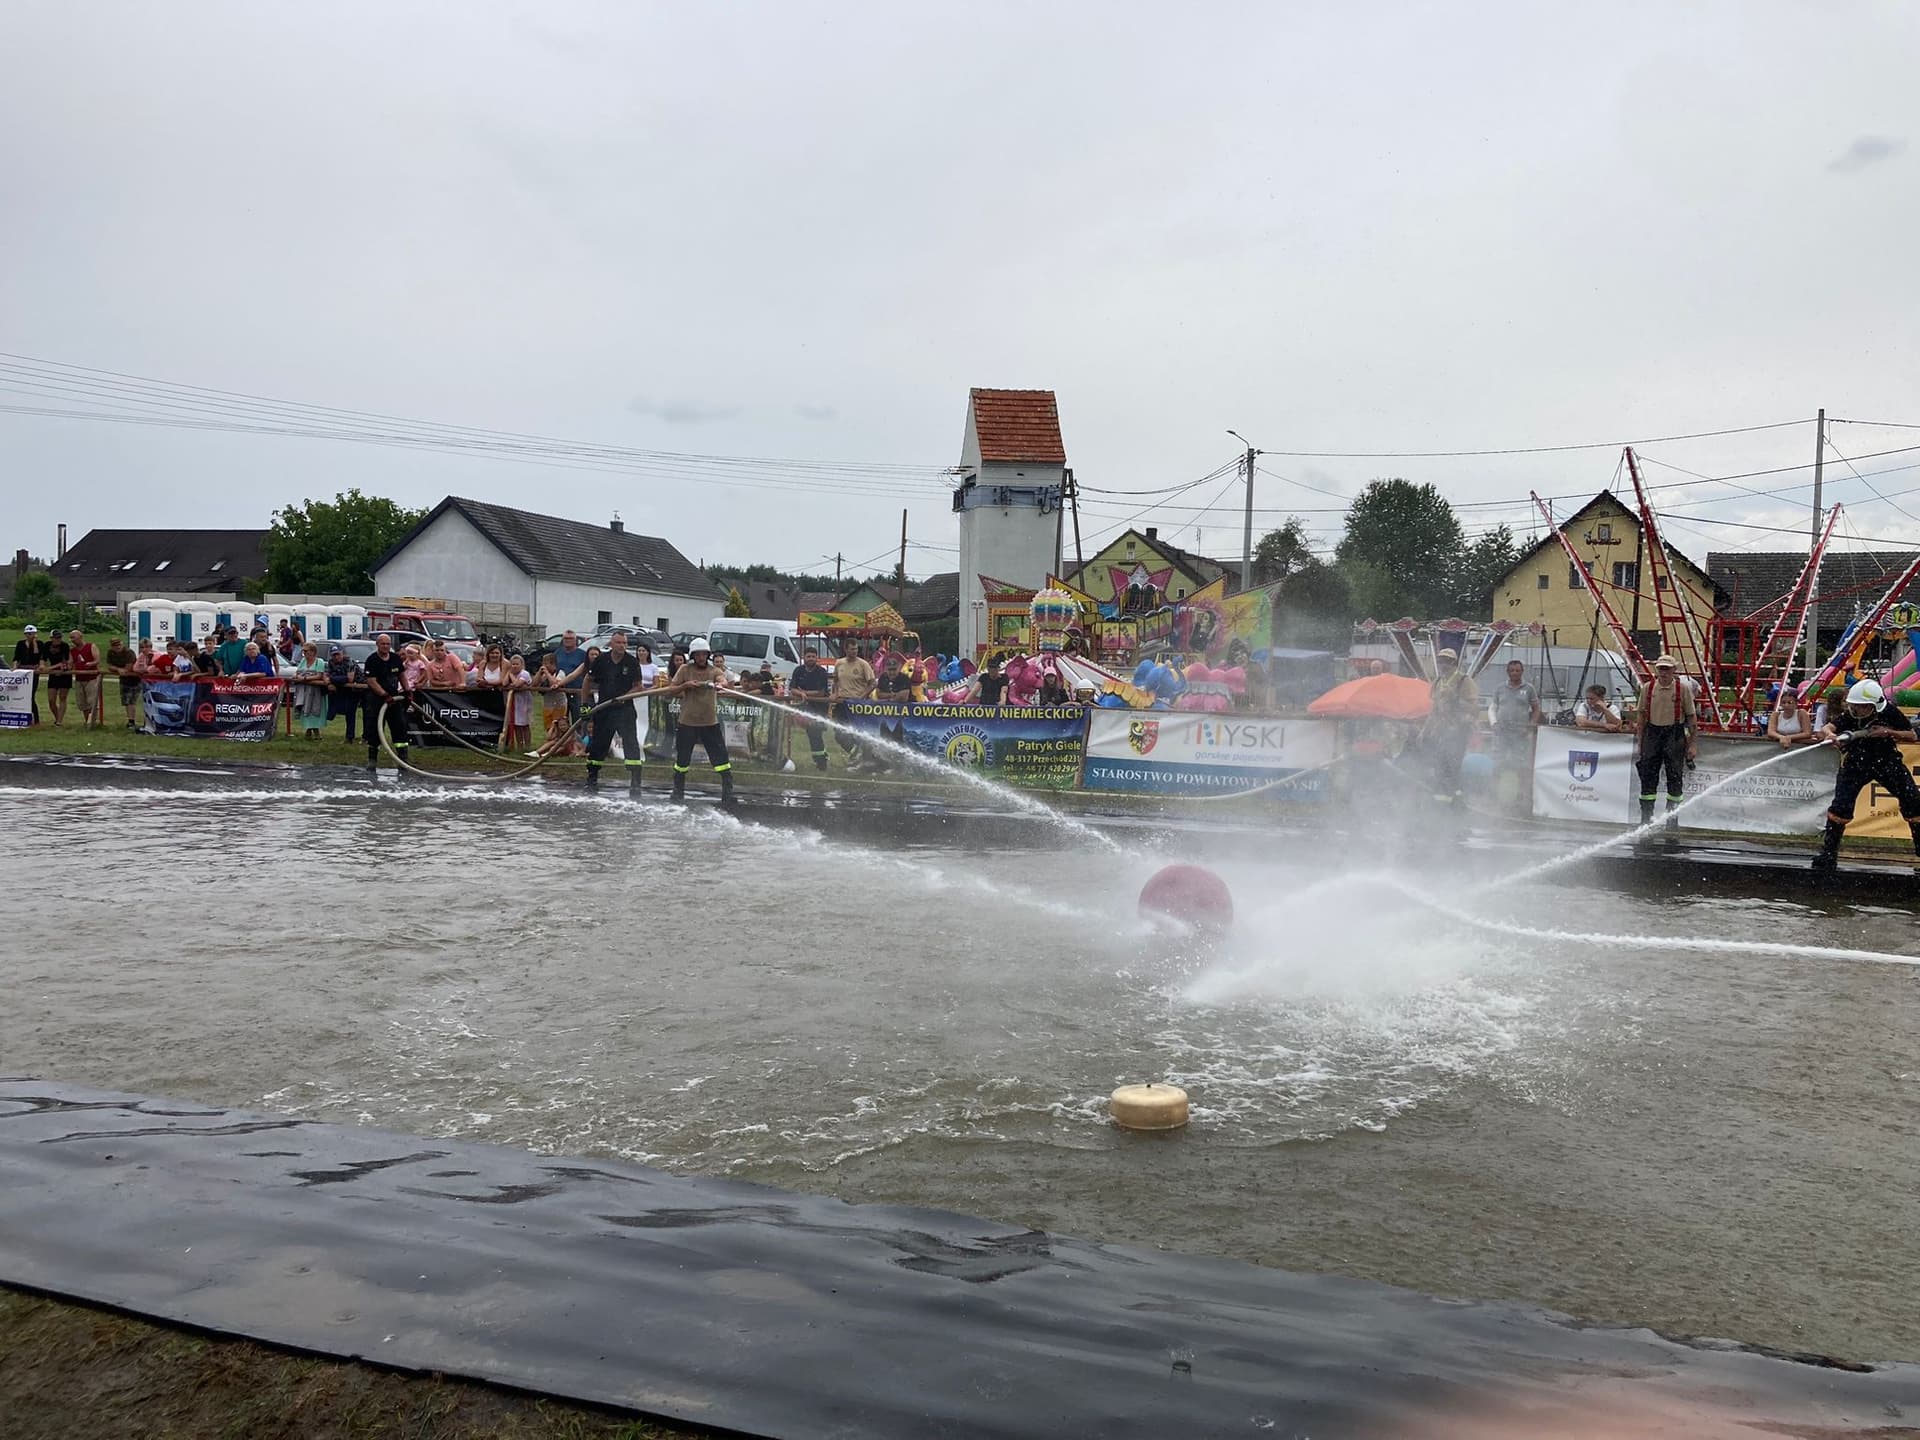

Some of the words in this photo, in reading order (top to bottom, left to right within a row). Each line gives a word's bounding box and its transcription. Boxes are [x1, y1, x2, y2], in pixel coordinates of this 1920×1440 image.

[1509, 599, 1520, 607] 97
[215, 703, 250, 714] REGINA
[252, 702, 273, 714] TOUR
[440, 708, 480, 719] PROS
[668, 703, 680, 712] OGR
[736, 706, 761, 715] NATURY
[913, 705, 996, 718] OWCZARKÓW
[1000, 708, 1083, 719] NIEMIECKICH
[1017, 740, 1053, 752] Patryk
[1005, 754, 1032, 763] 48-317
[1092, 767, 1173, 782] STAROSTWO
[1176, 775, 1257, 787] POWIATOWE
[1718, 774, 1814, 788] FANSOWANA
[1750, 787, 1815, 798] KORFANTÓW
